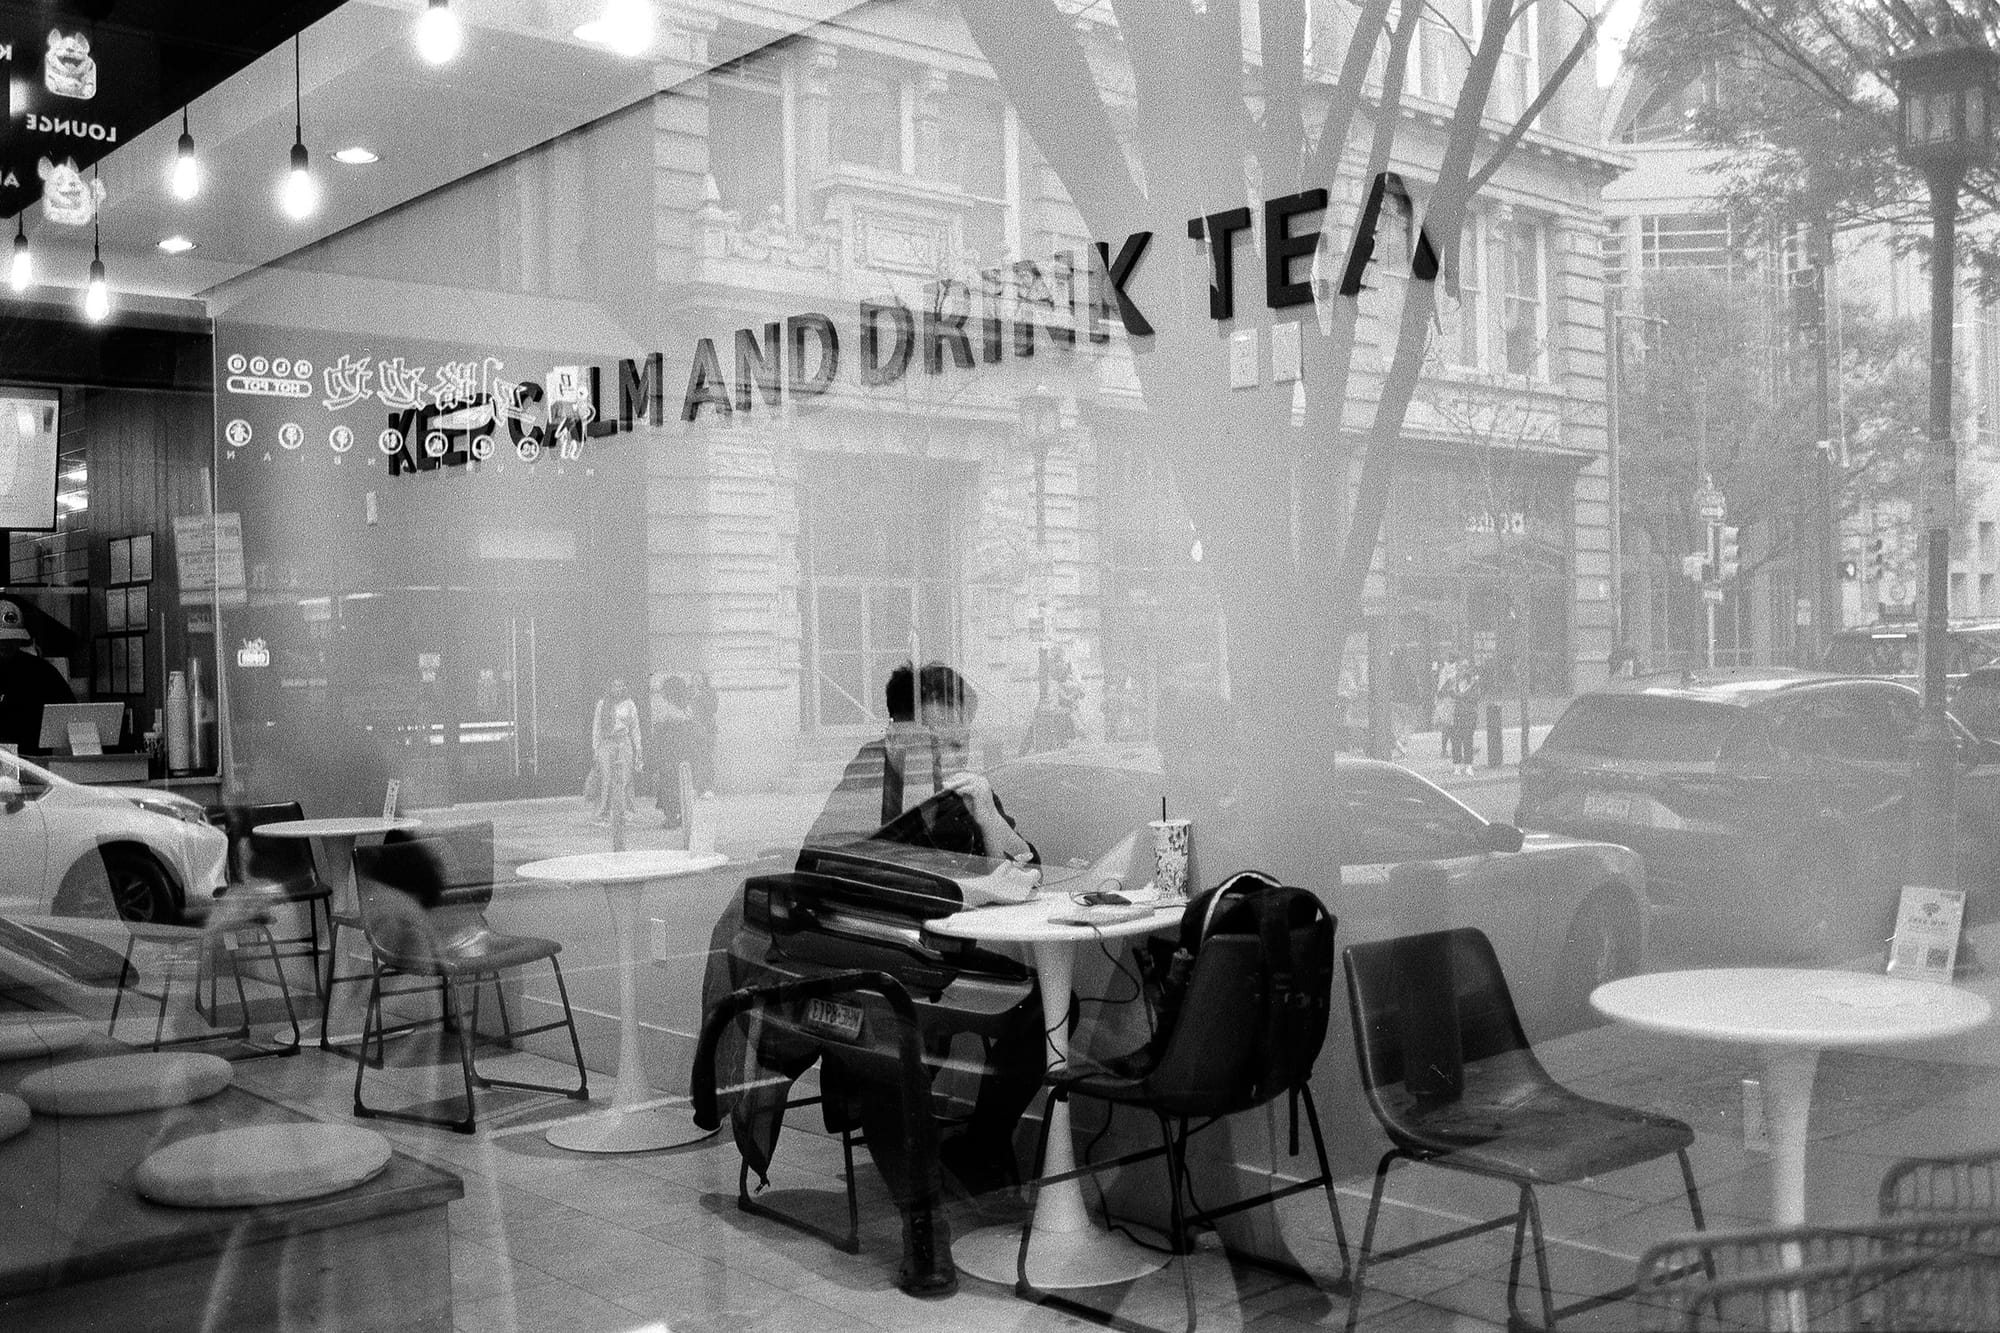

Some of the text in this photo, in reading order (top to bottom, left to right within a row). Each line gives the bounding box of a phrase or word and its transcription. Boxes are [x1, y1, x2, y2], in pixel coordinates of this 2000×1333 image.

[680, 313, 840, 421] AND
[859, 232, 1154, 387] DRINK
[1188, 171, 1438, 320] TEA
